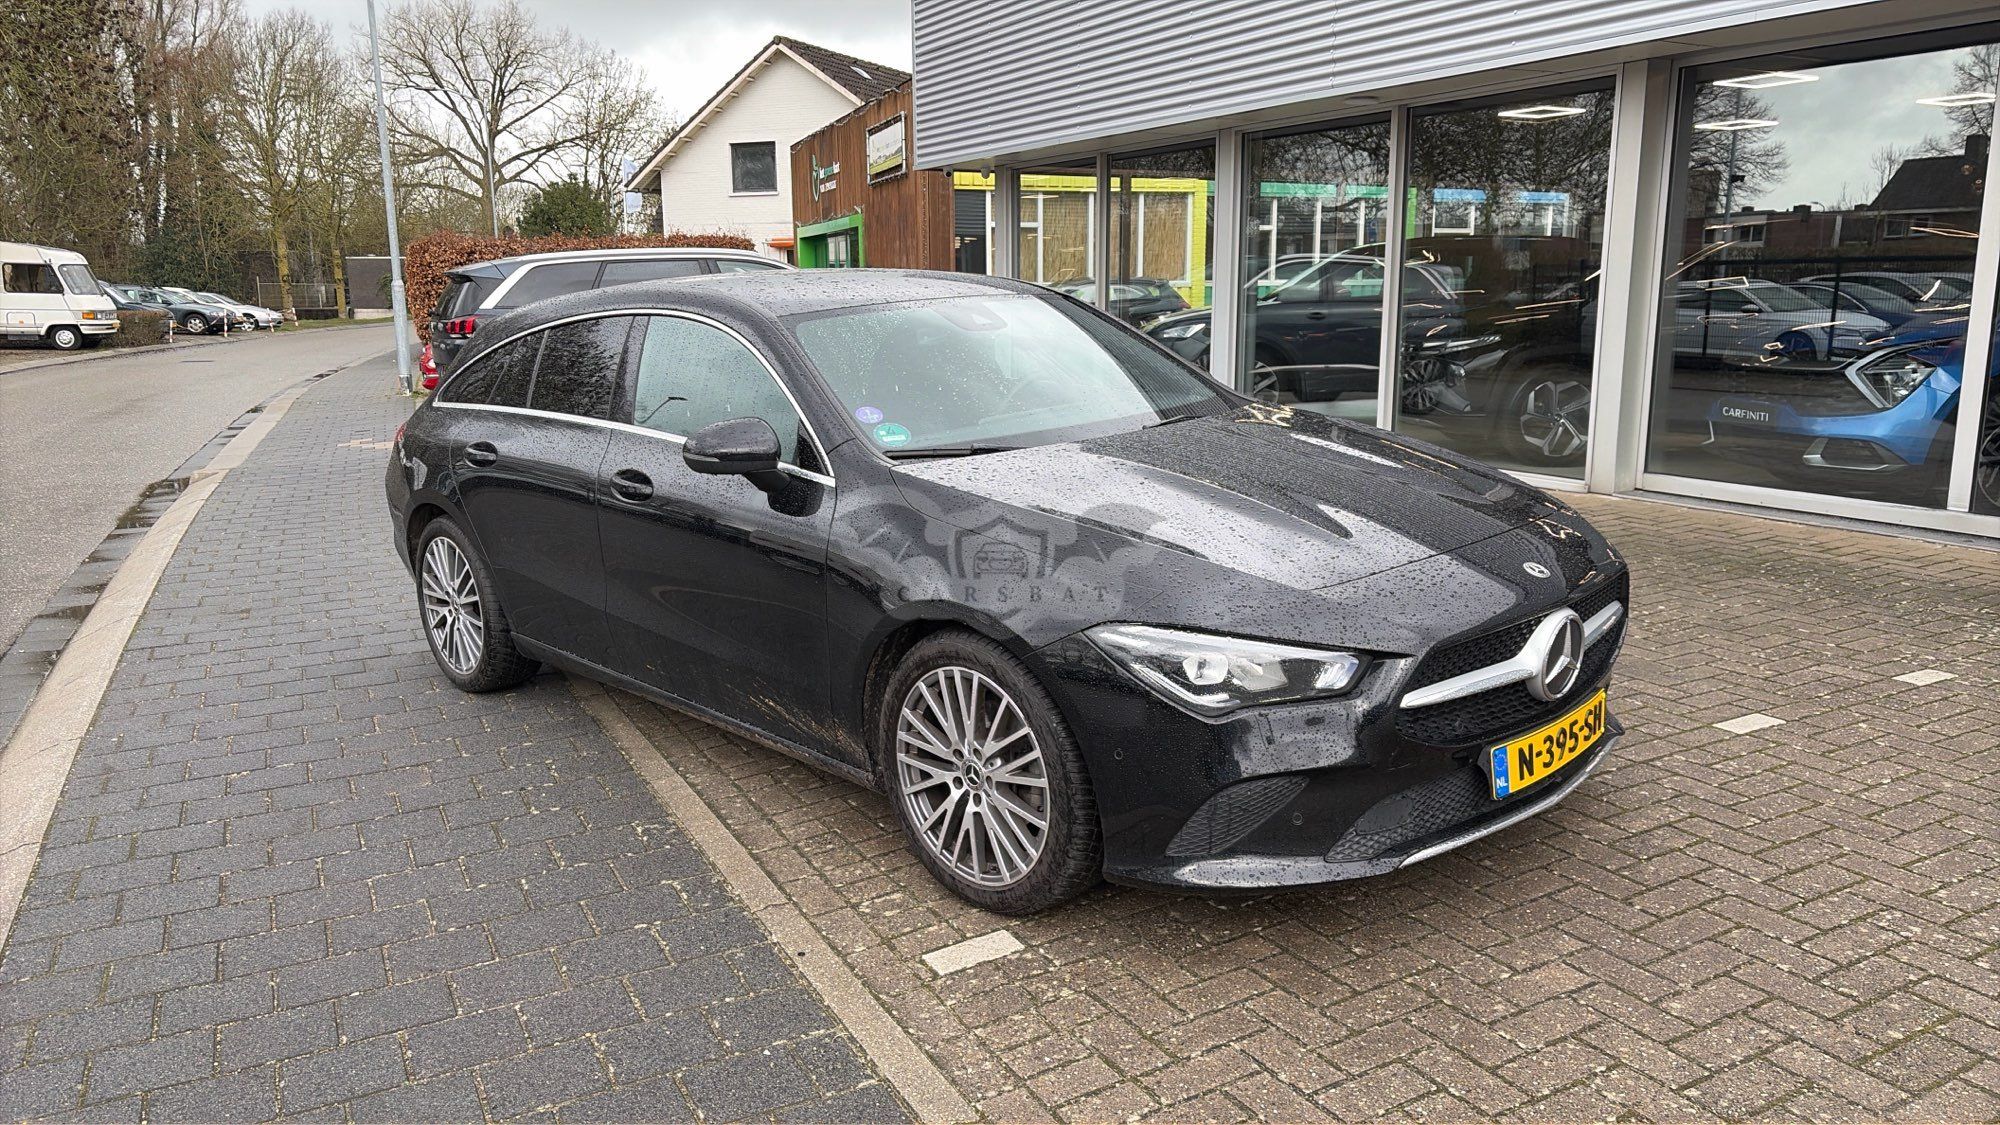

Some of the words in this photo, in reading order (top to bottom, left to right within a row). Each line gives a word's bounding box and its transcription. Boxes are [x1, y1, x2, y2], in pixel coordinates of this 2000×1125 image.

[1722, 406, 1769, 422] CARFINITI
[1518, 700, 1603, 781] N-395-SH
[1496, 776, 1508, 789] NL
